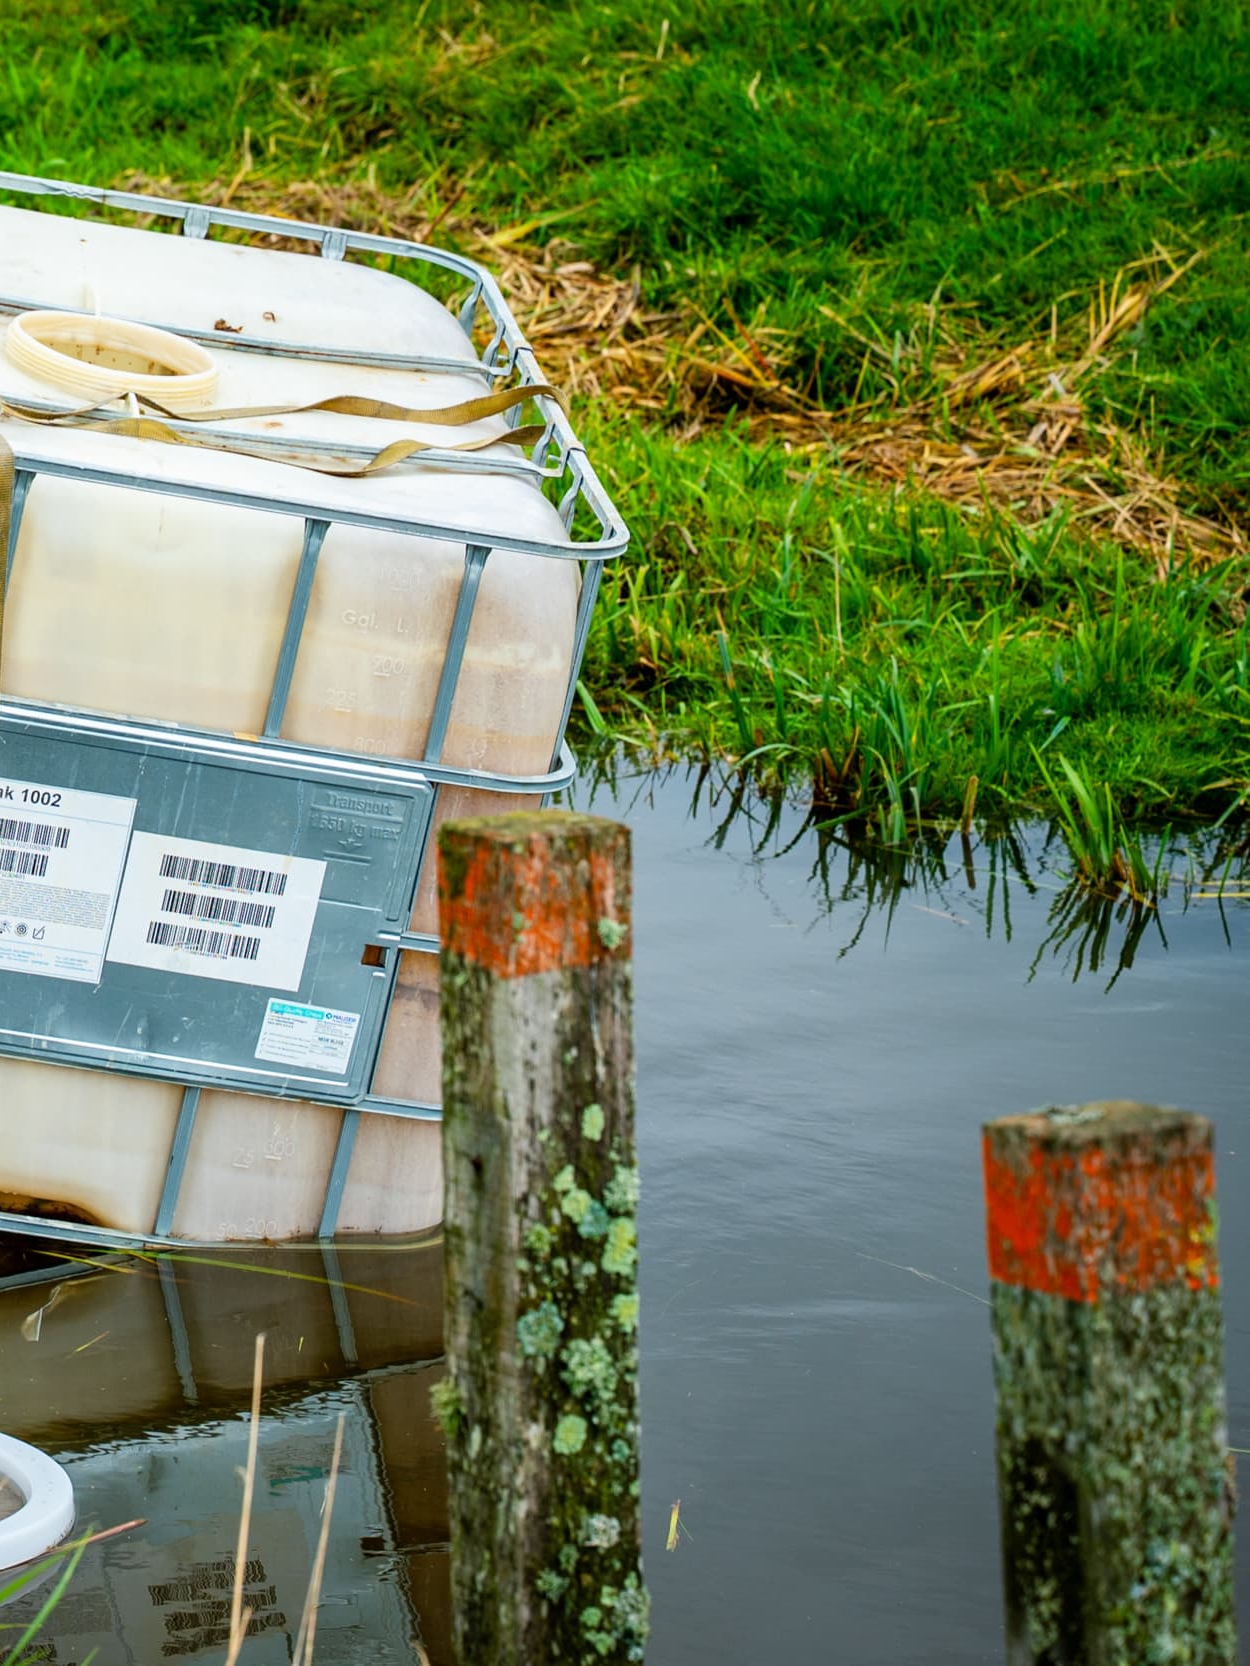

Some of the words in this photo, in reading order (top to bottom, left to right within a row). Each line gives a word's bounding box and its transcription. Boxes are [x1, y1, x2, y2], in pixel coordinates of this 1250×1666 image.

[341, 608, 378, 629] Gal.
[372, 655, 405, 674] 900
[21, 788, 62, 808] 1002
[327, 791, 395, 816] Transport
